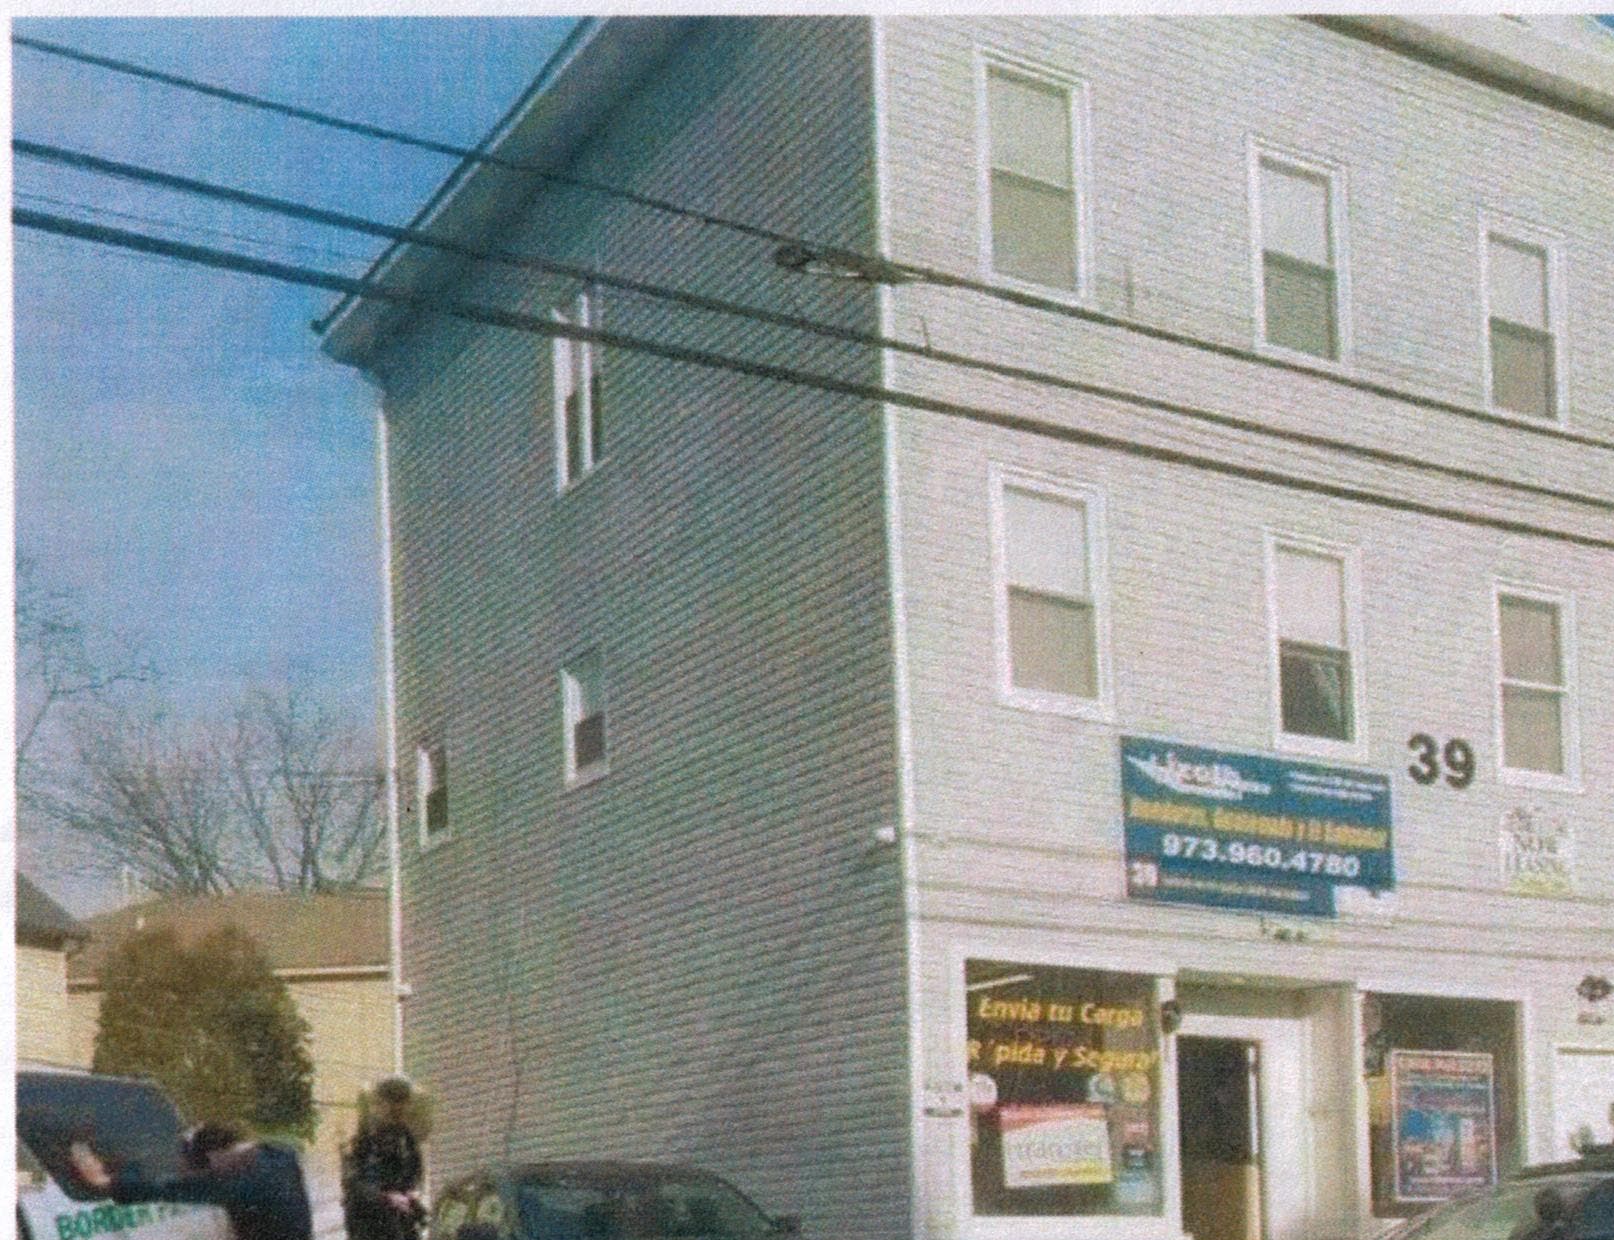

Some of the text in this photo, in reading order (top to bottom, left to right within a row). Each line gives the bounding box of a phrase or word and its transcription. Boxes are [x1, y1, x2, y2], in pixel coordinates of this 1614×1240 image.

[1408, 732, 1477, 789] 39
[1162, 832, 1361, 877] 973.960.4780
[980, 997, 1042, 1022] Envia
[1049, 1003, 1073, 1022] tu
[1054, 1049, 1069, 1070] y
